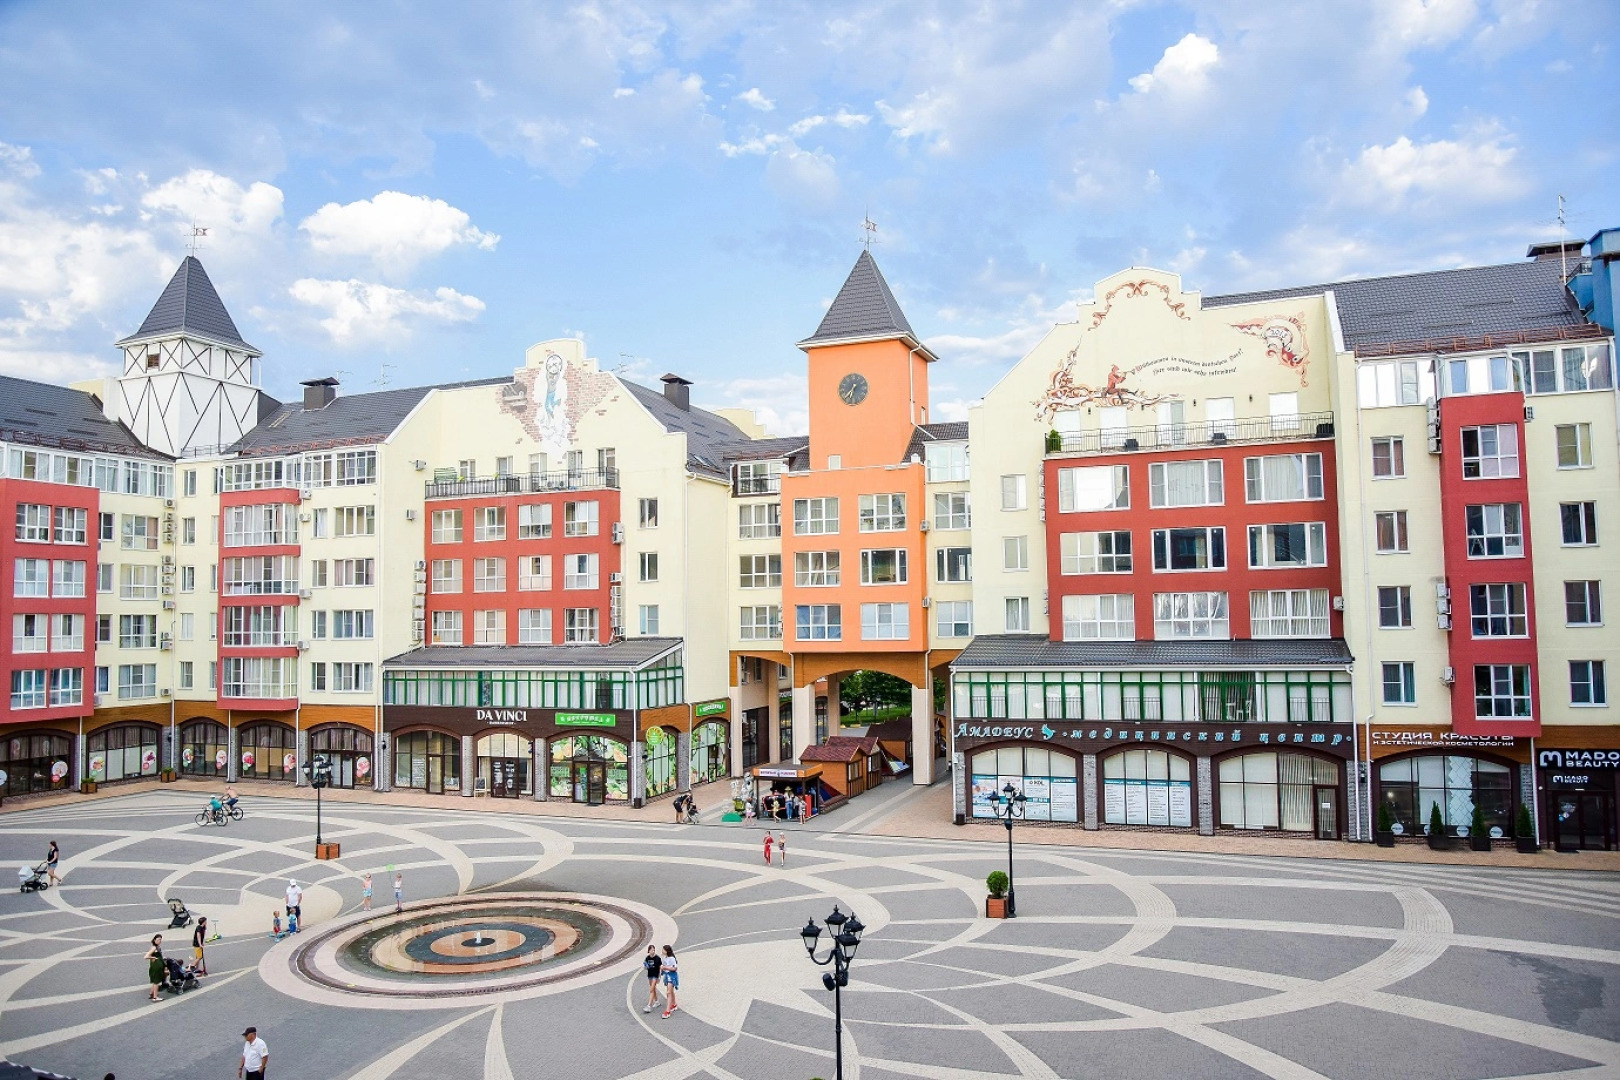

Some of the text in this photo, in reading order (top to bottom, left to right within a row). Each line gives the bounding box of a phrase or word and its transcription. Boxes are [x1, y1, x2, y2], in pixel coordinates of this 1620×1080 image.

[476, 709, 528, 722] DA VINCI
[1259, 732, 1343, 745] центр
[1371, 732, 1433, 740] СТУДИЯ
[1565, 751, 1620, 760] MADO
[1565, 760, 1620, 768] BEAUTY
